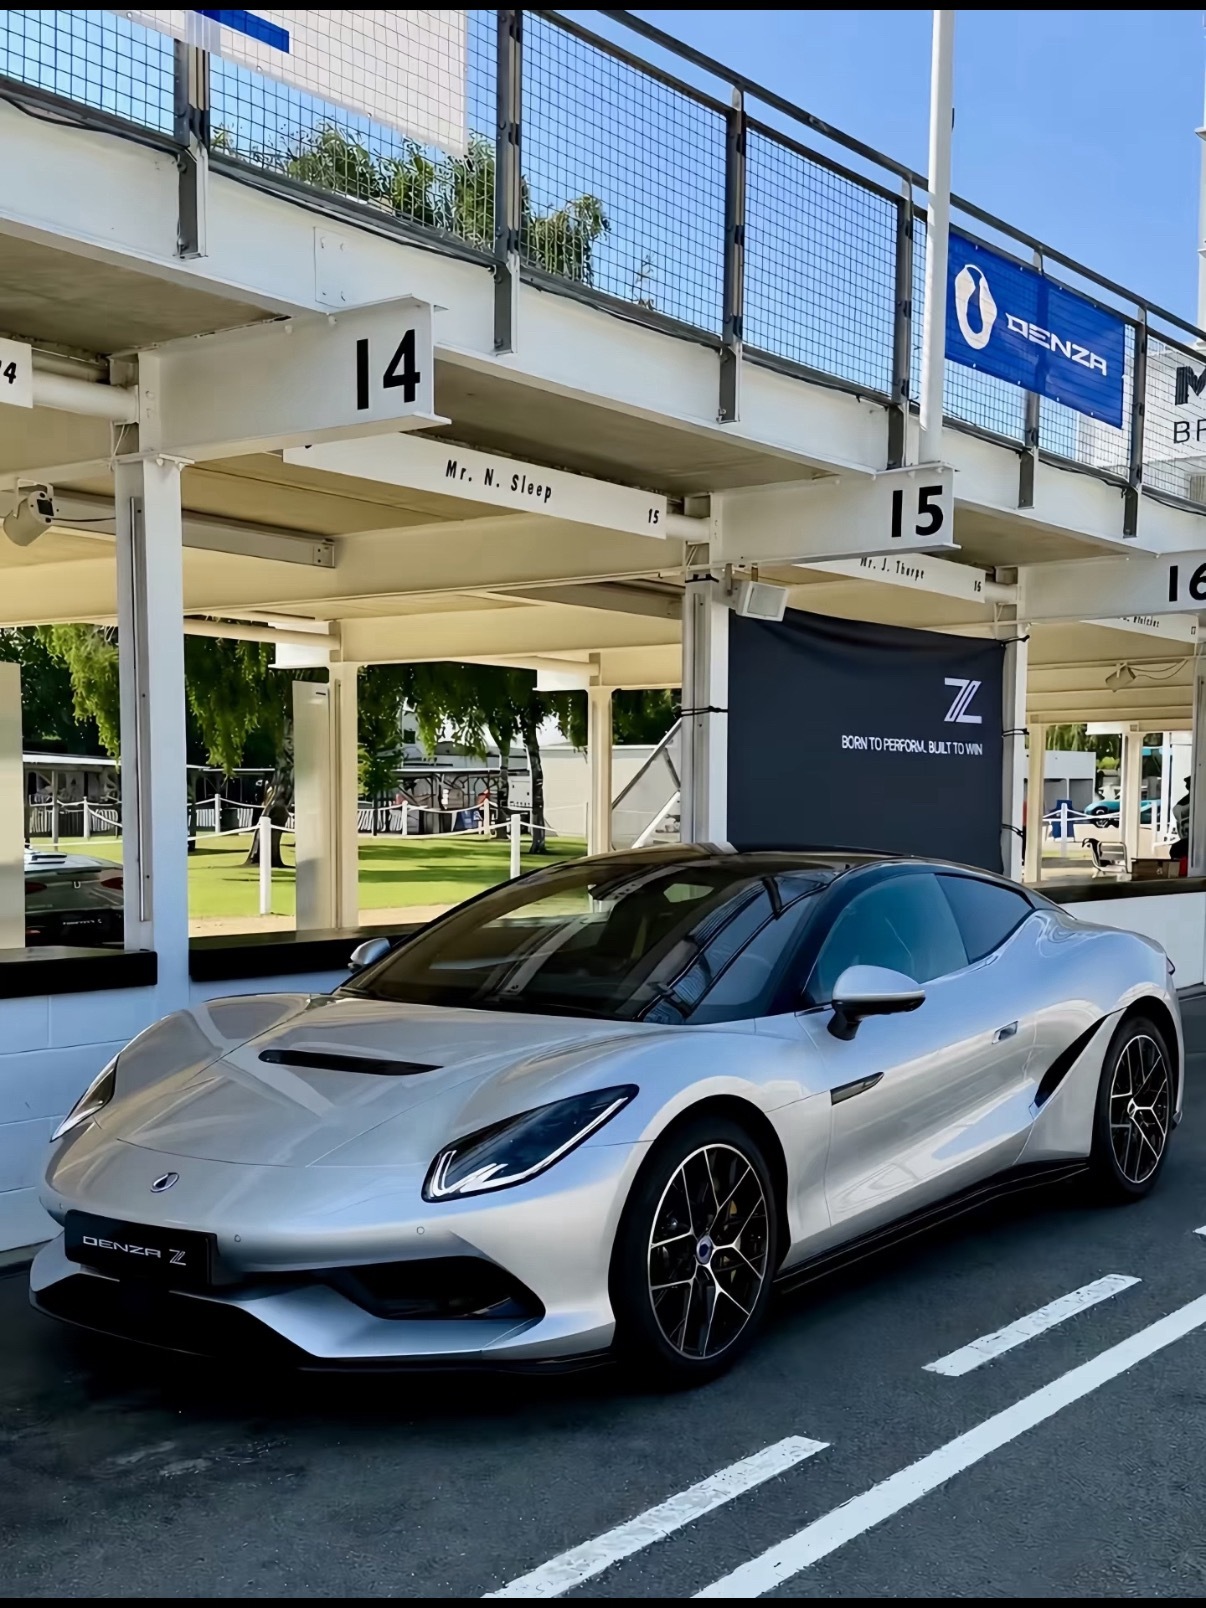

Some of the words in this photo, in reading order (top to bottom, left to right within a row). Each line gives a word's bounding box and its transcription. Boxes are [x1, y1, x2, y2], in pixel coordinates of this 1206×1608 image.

[1005, 312, 1107, 377] DENZA
[356, 328, 421, 411] 14
[445, 459, 472, 482] Mr.
[484, 467, 500, 488] N.
[510, 473, 552, 503] Sleep
[648, 508, 660, 524] 15
[891, 484, 944, 538] 15
[1168, 562, 1206, 603] 16
[841, 734, 868, 750] BORN
[869, 736, 882, 751] TO
[928, 740, 952, 755] BUILT
[952, 741, 964, 755] TO
[966, 743, 983, 756] WIN
[82, 1235, 162, 1259] DENZA
